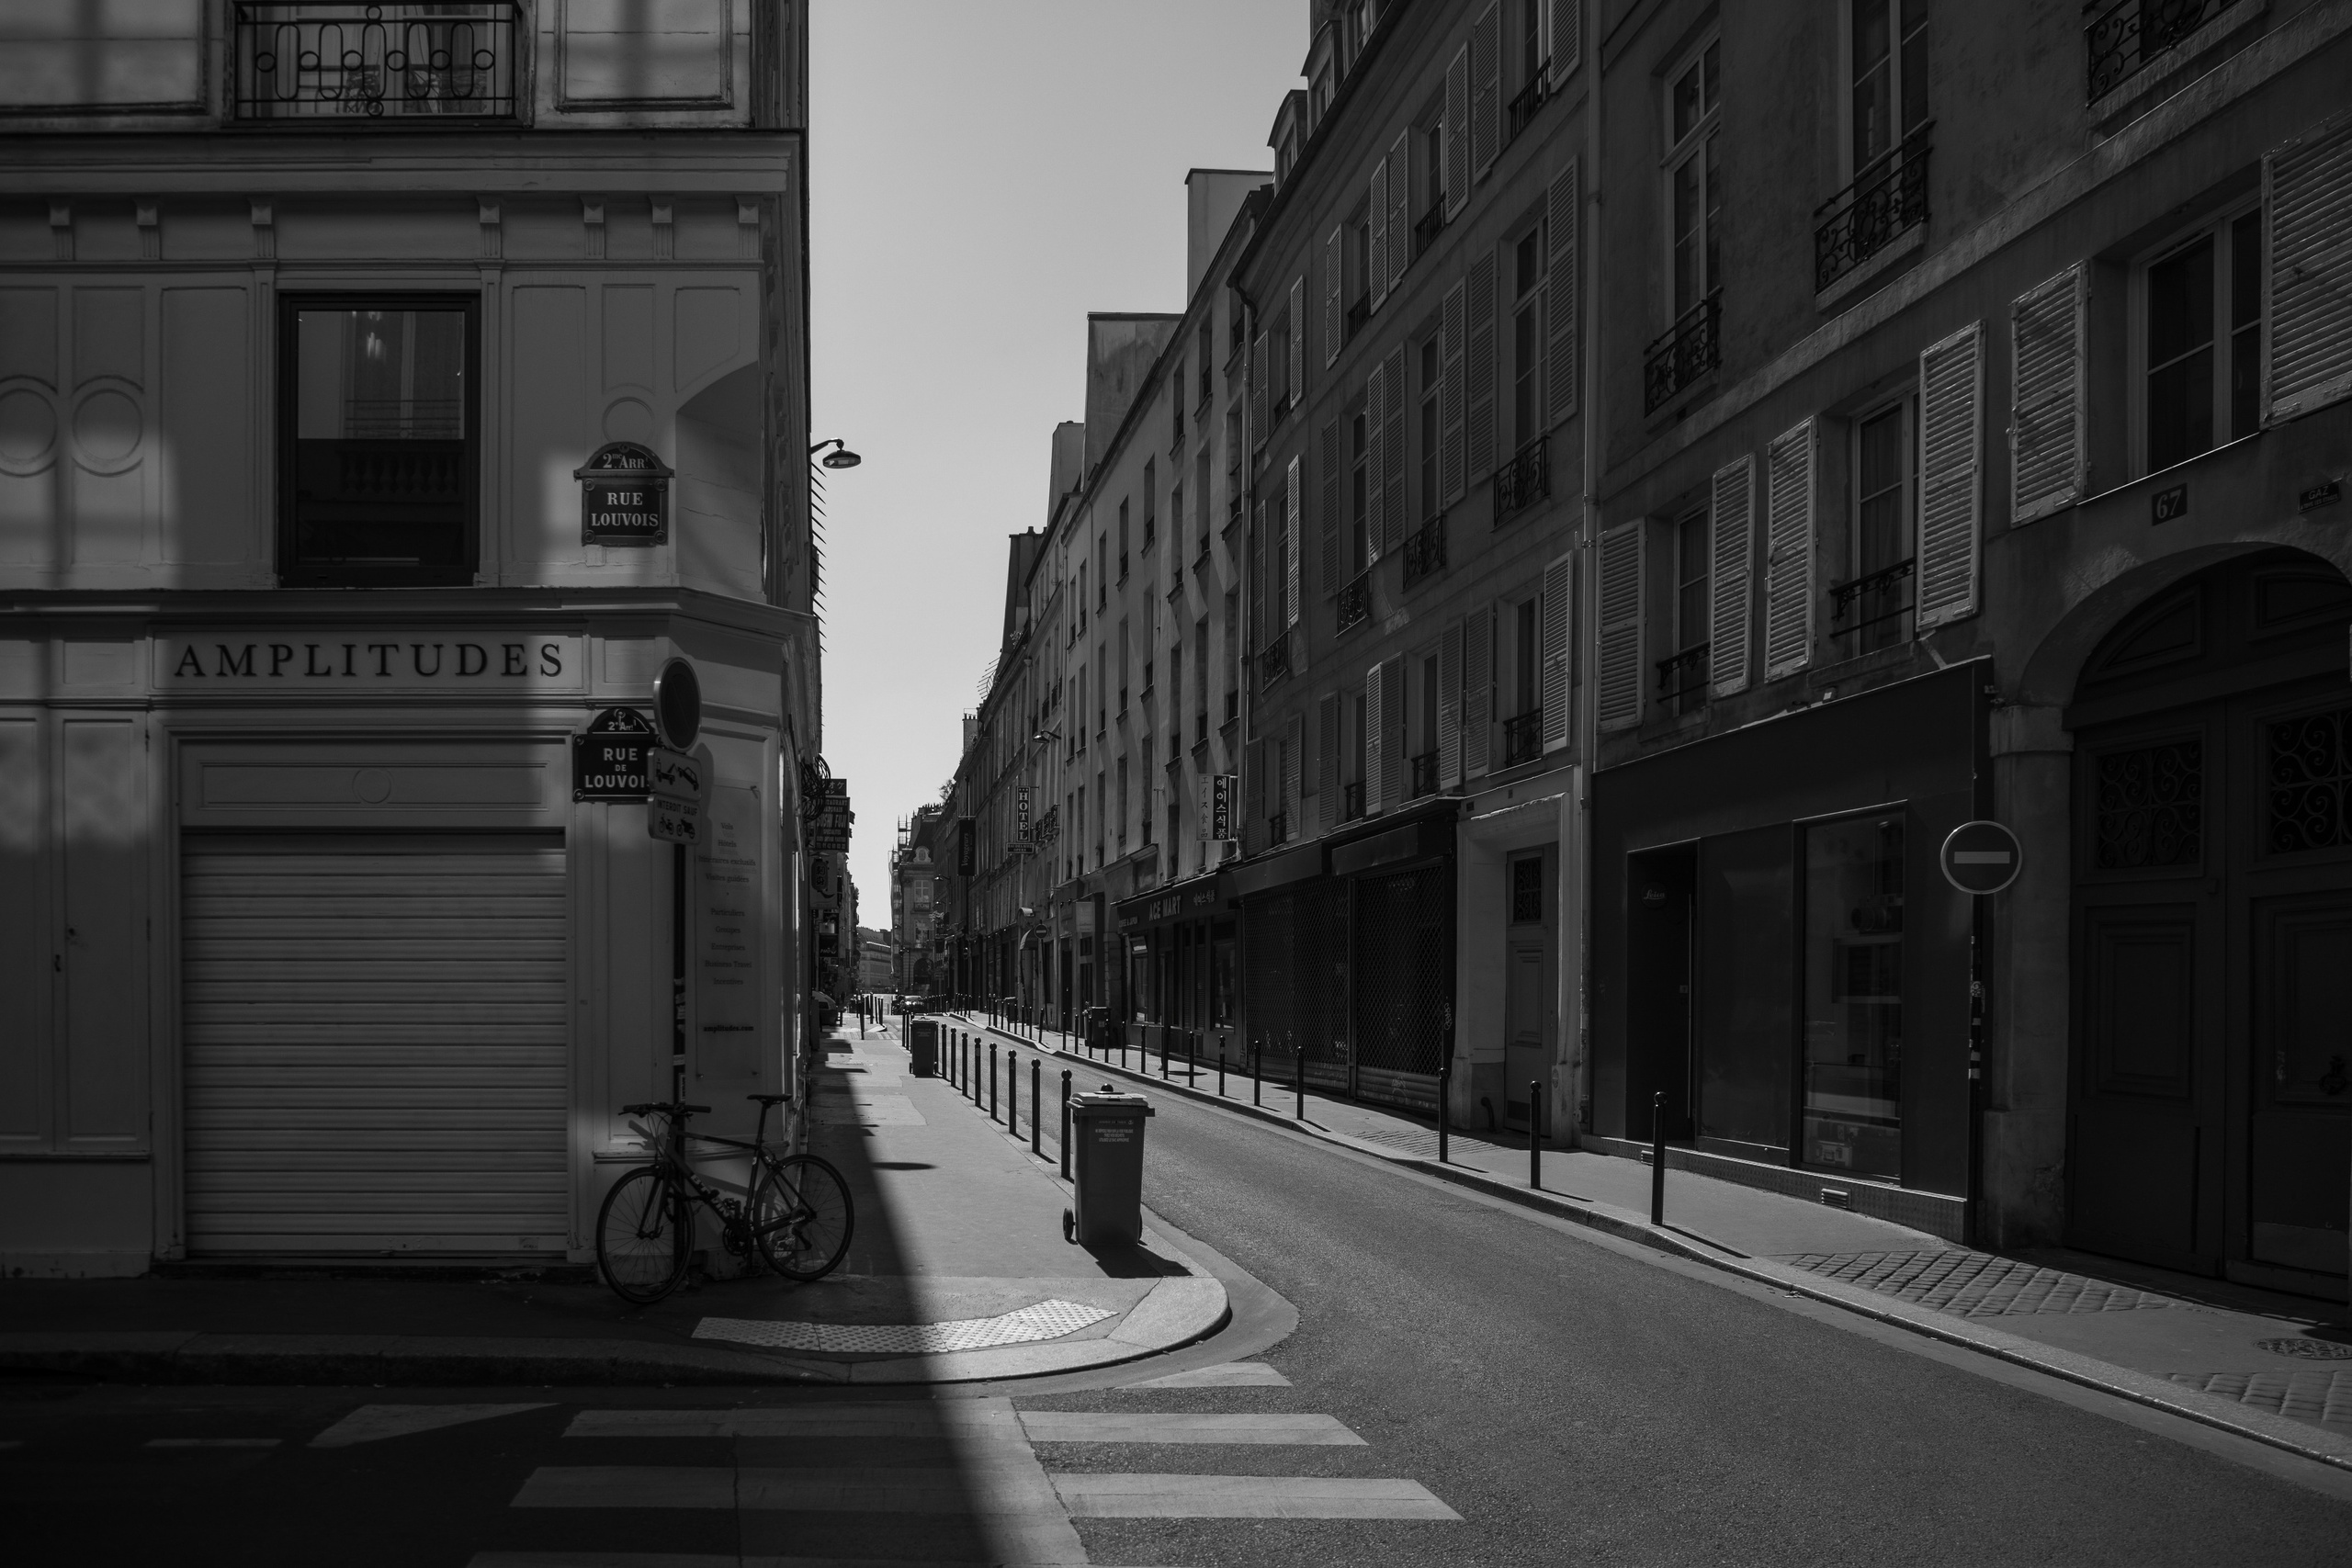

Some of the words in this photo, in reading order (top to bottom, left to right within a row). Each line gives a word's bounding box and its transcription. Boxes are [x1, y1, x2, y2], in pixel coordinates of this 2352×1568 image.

[606, 492, 643, 506] RUE
[2308, 485, 2329, 500] GAZ
[2156, 489, 2182, 519] 67
[591, 513, 659, 526] LOUVOIS
[174, 644, 562, 677] AMPLITUDES
[603, 747, 639, 761] RUE
[614, 763, 628, 773] DE
[583, 774, 650, 789] LOUVOI
[657, 799, 682, 813] INTERDIT
[683, 805, 698, 816] SAUF
[1216, 776, 1227, 839] 에이스식품
[1019, 792, 1028, 840] HOTEL
[720, 822, 734, 830] Vols
[961, 832, 970, 866] Voyageurs
[705, 873, 726, 881] Visites
[1643, 888, 1666, 900] Leica
[710, 908, 745, 917] Particuliers
[1149, 900, 1161, 921] ACE
[1162, 895, 1181, 918] MART
[715, 926, 741, 935] Groupes
[711, 942, 745, 953] Entreprises
[705, 960, 732, 968] Business
[733, 960, 752, 968] Travel
[703, 1024, 754, 1033] amplitudes.com
